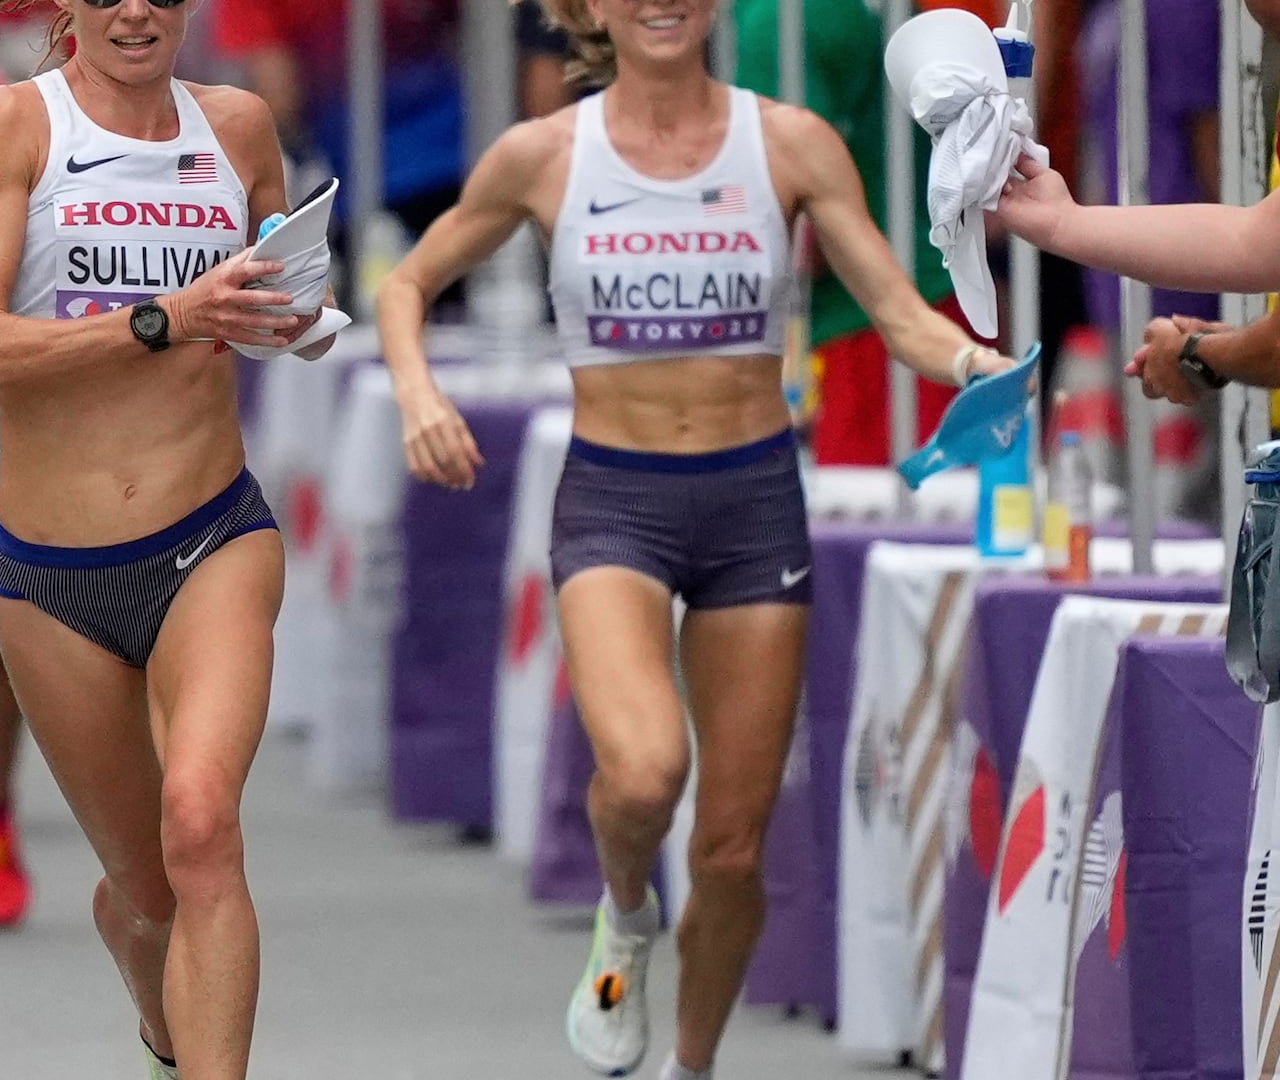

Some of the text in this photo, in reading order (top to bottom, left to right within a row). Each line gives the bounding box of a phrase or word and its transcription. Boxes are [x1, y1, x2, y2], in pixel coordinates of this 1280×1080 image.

[60, 201, 237, 230] HONDA
[586, 232, 761, 255] HONDA
[591, 272, 761, 309] McCLAIN
